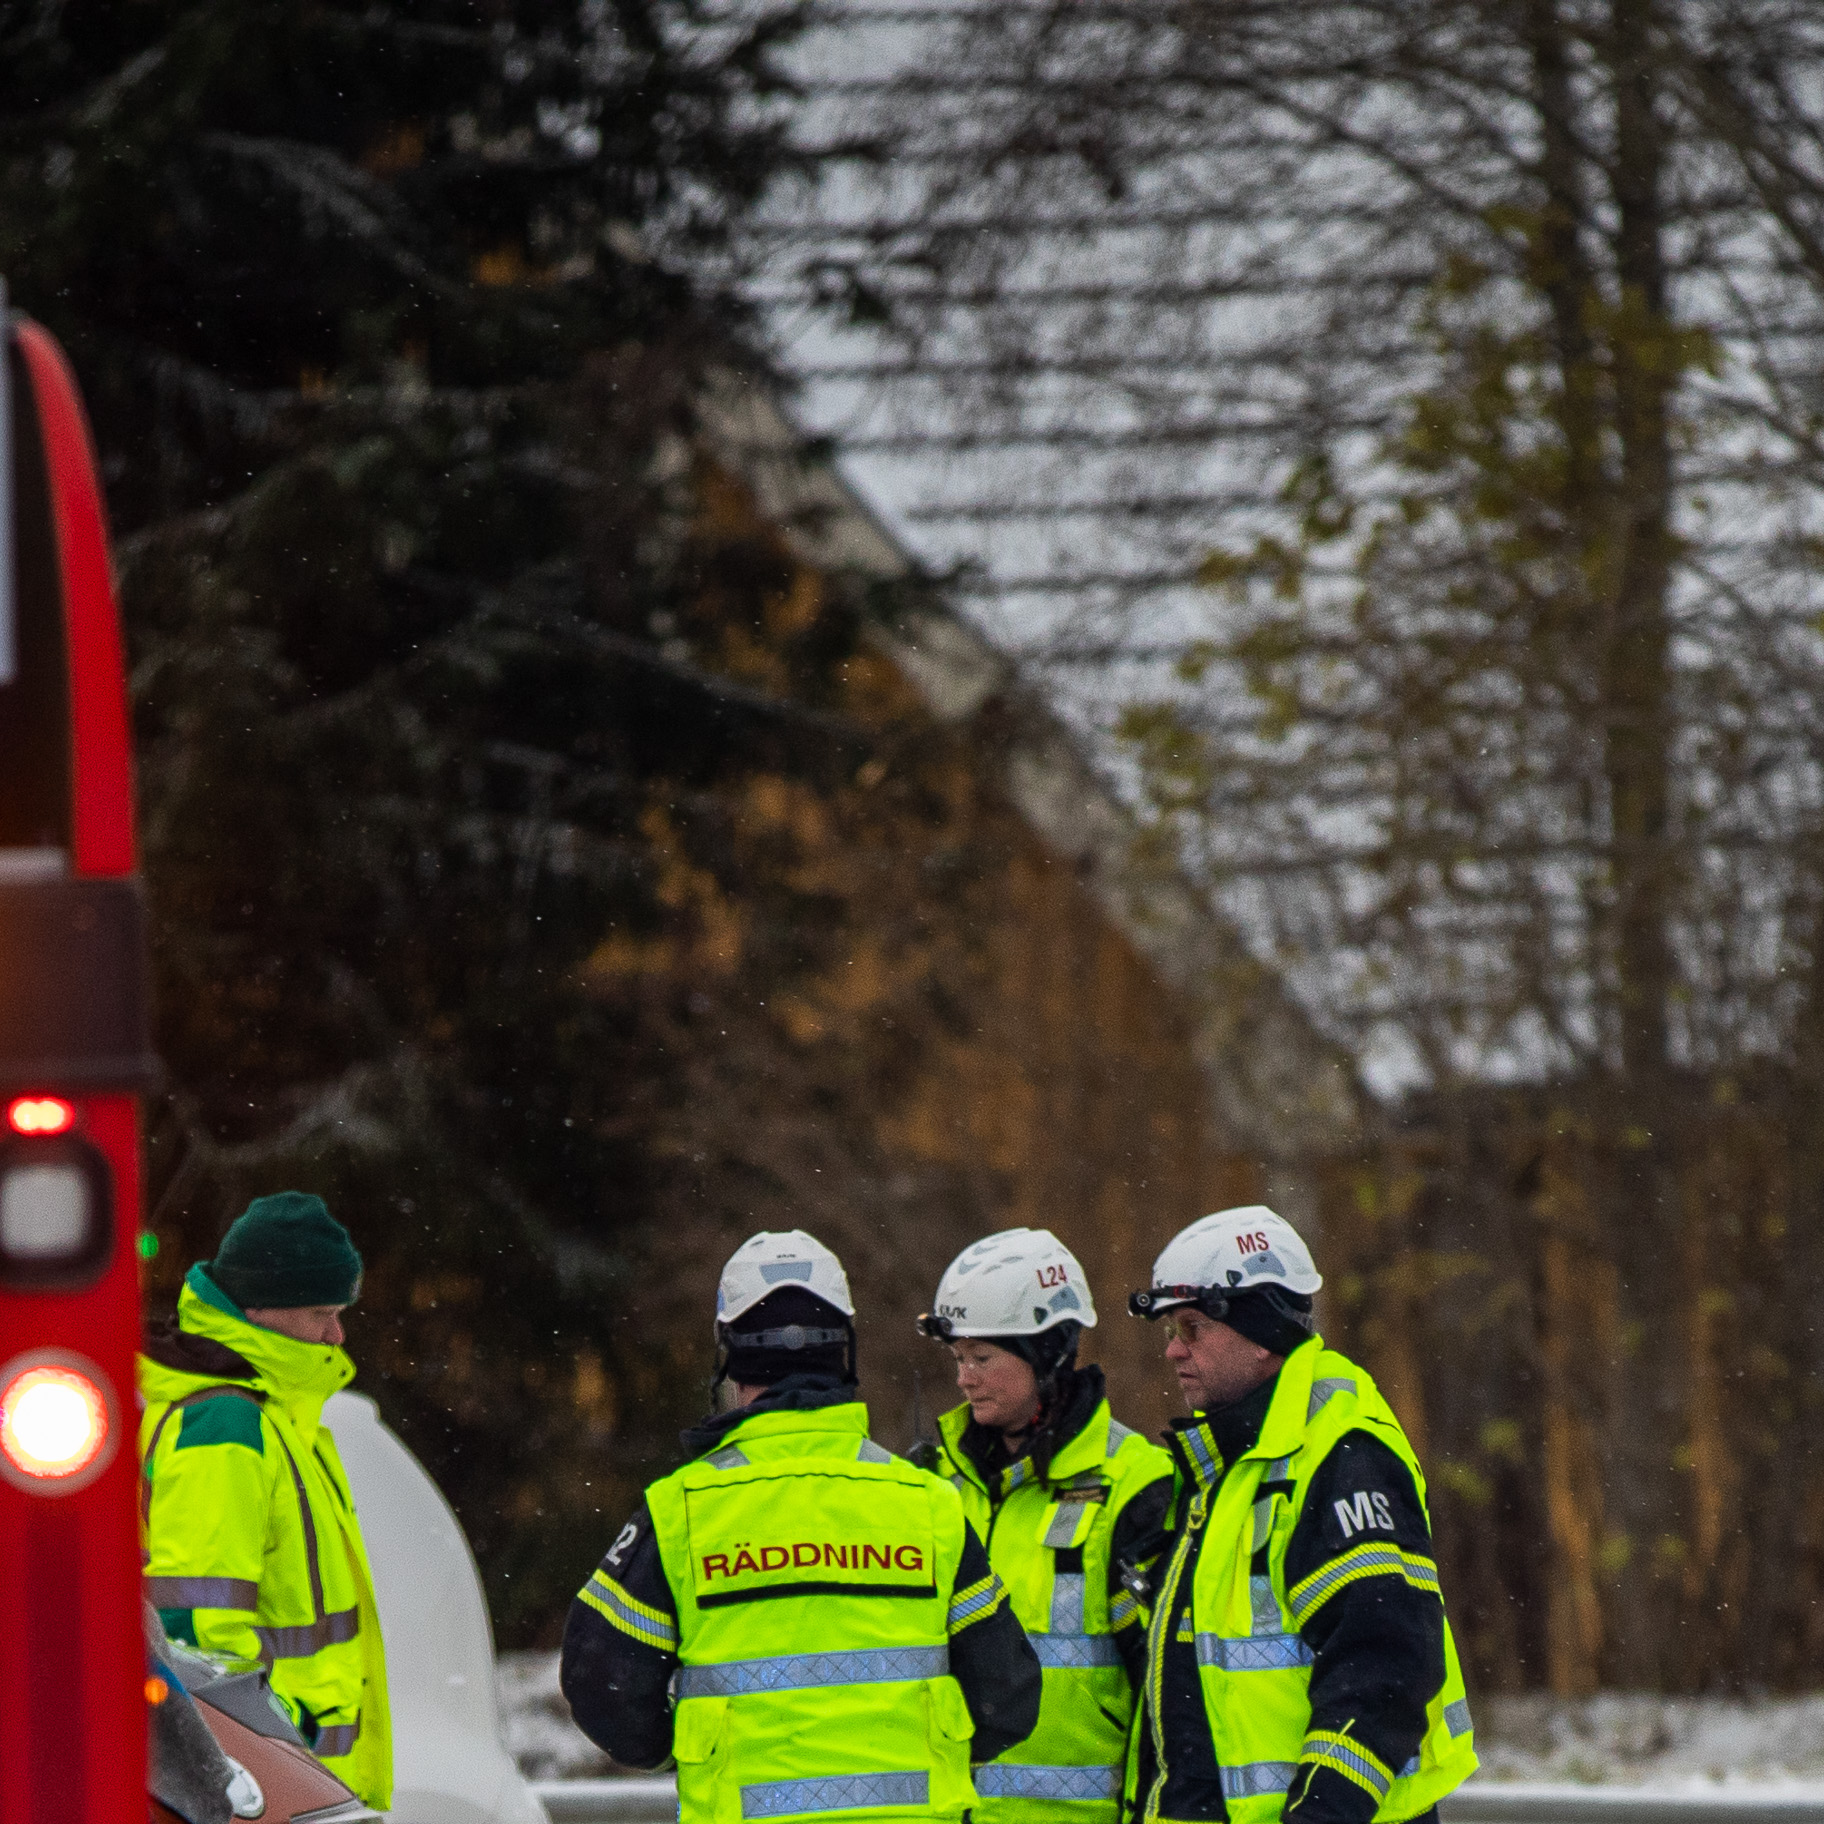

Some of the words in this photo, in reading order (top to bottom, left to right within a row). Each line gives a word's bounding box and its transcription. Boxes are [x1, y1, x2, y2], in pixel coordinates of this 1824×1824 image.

[1236, 1231, 1269, 1254] MS
[1036, 1264, 1068, 1289] L24
[1334, 1491, 1395, 1538] MS
[606, 1523, 637, 1565] 2
[701, 1542, 924, 1580] RÄDDNING
